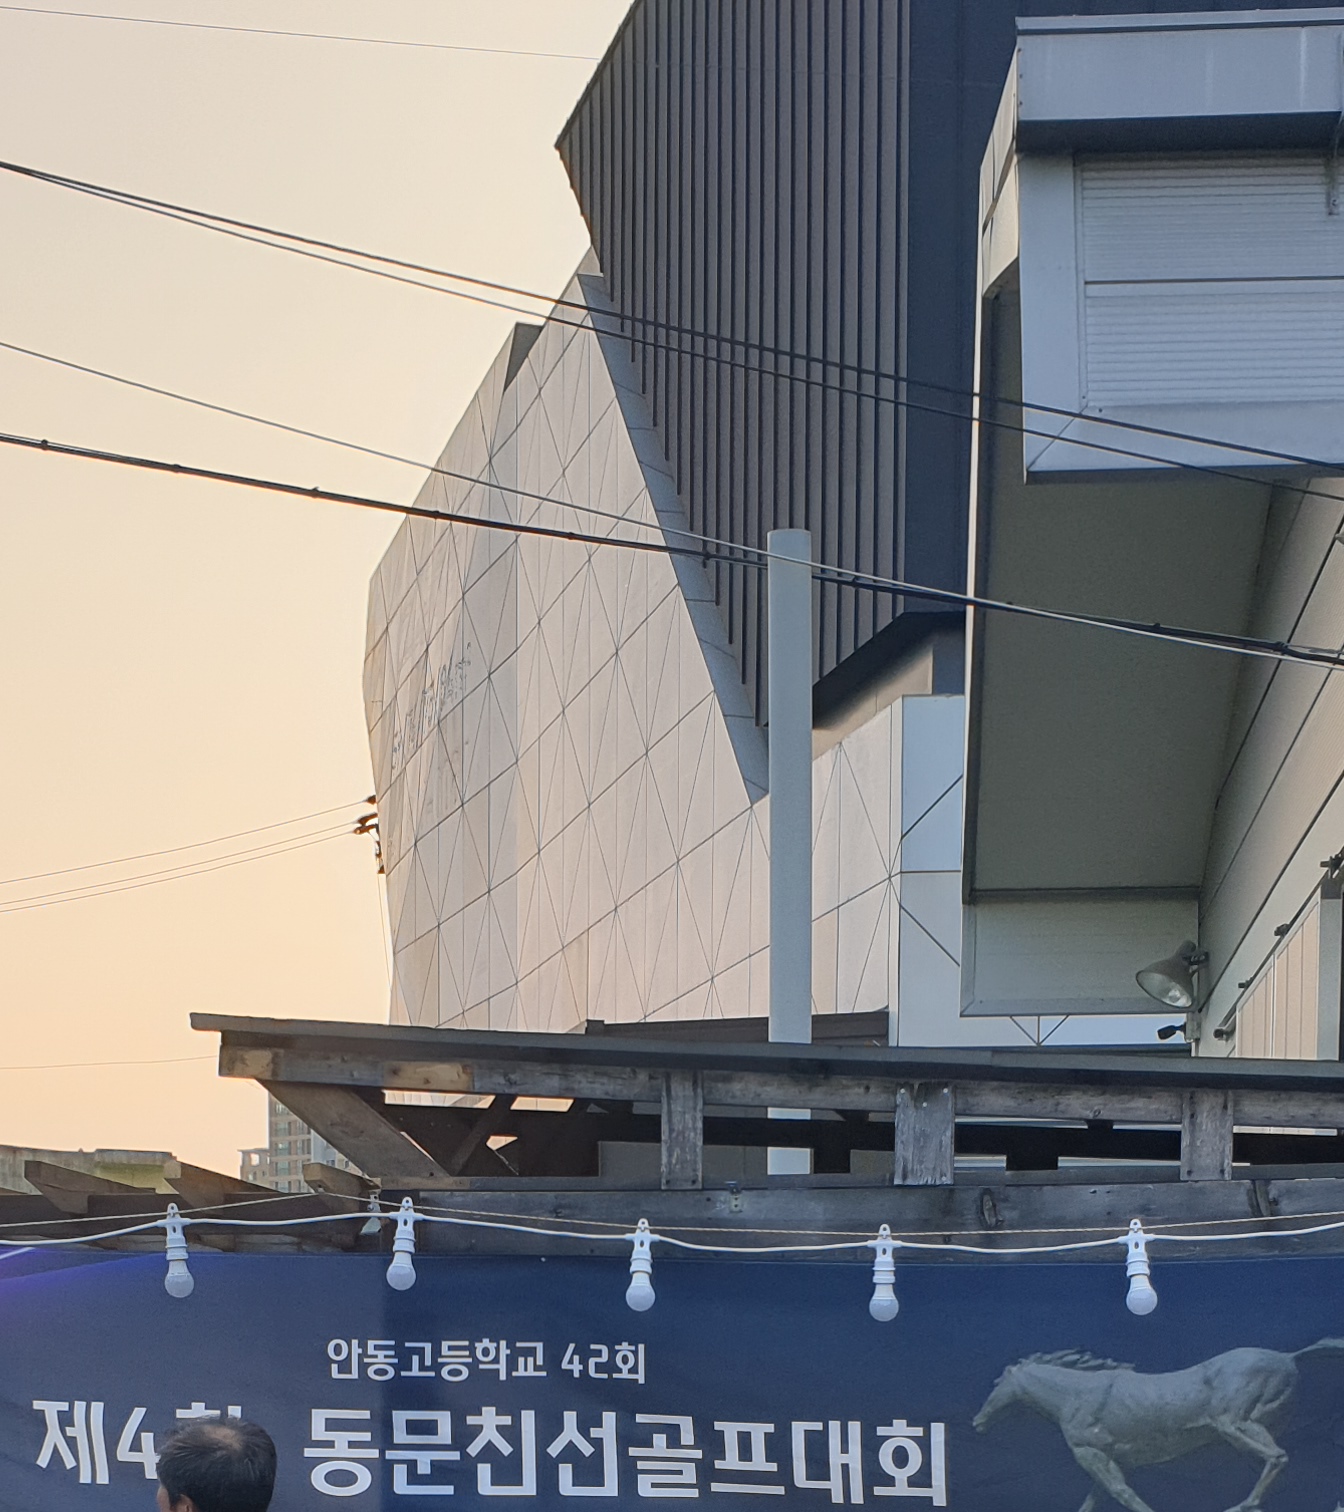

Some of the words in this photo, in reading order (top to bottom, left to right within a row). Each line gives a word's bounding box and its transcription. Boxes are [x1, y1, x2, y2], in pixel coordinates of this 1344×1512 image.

[327, 1337, 547, 1382] 안동고등학교
[560, 1341, 646, 1385] 42회
[32, 1400, 243, 1485] 제4
[303, 1406, 947, 1507] 동문친선골프대회
